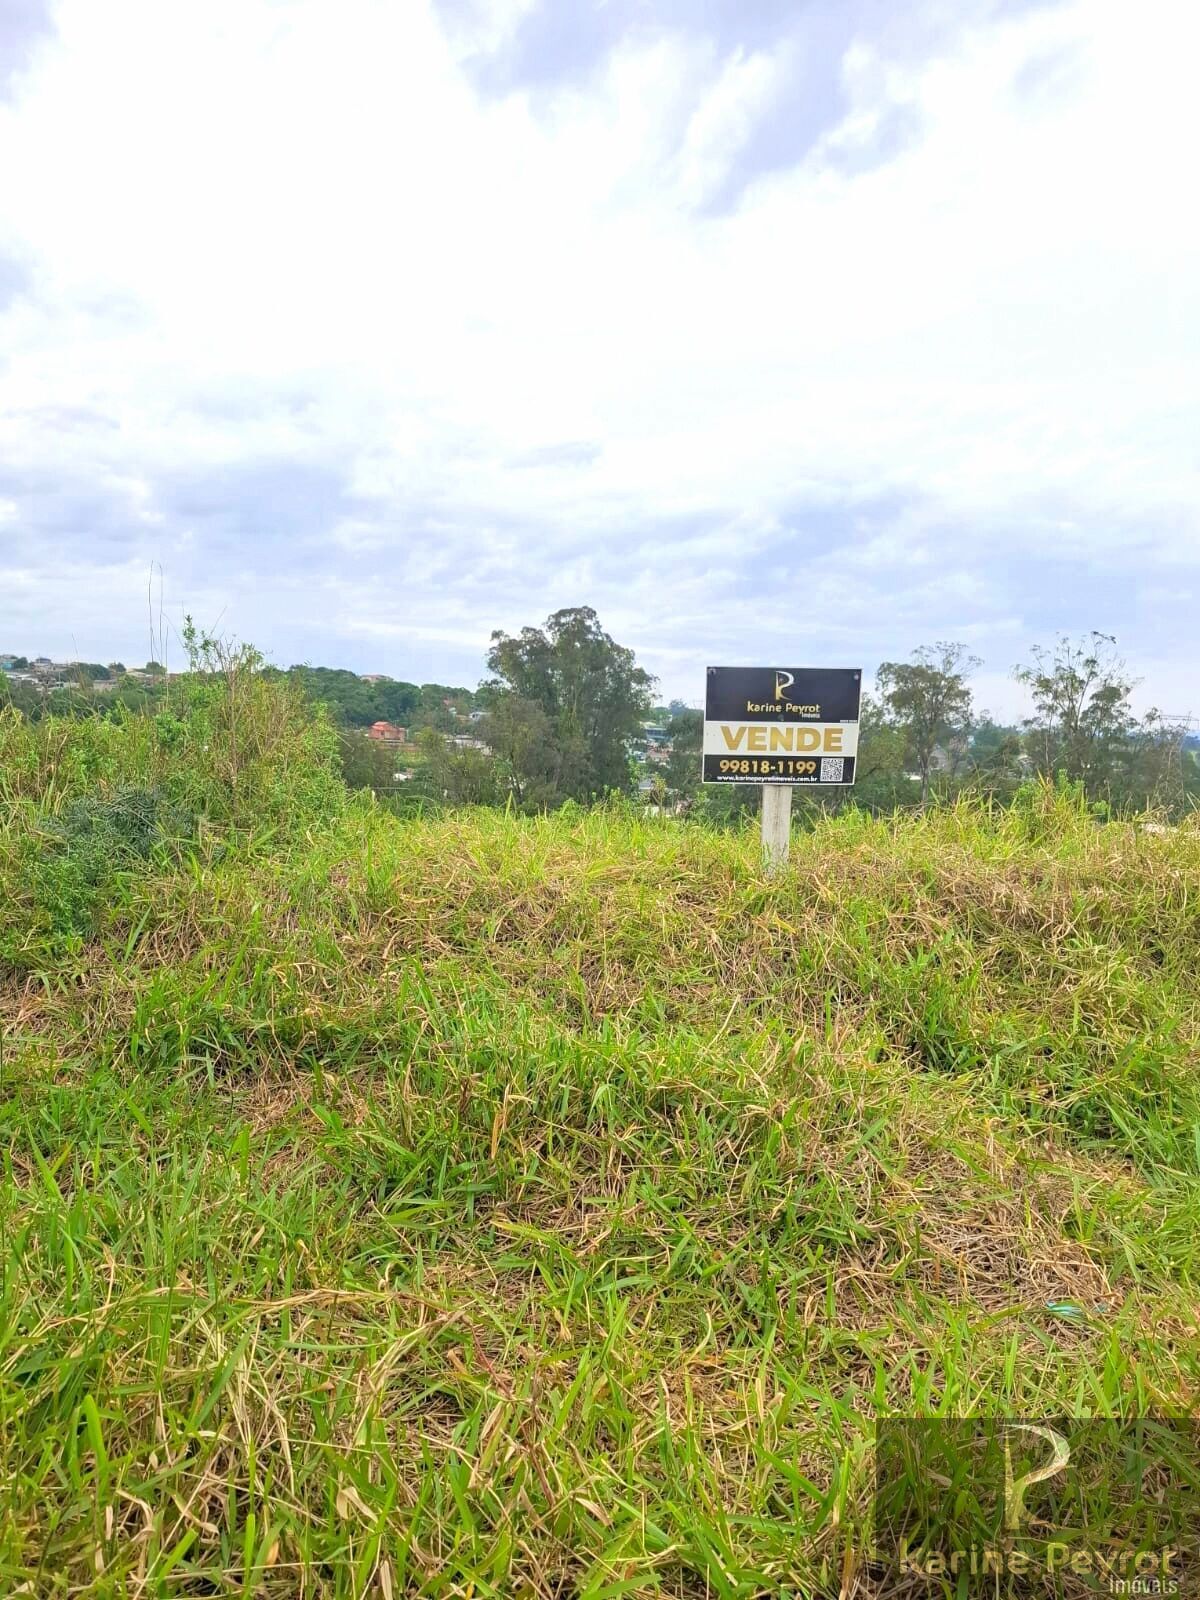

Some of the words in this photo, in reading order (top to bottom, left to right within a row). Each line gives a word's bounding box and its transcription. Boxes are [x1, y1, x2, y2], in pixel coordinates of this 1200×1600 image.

[785, 702, 821, 715] Peyrot
[720, 725, 844, 752] VENDE
[719, 759, 817, 774] 99818-1199
